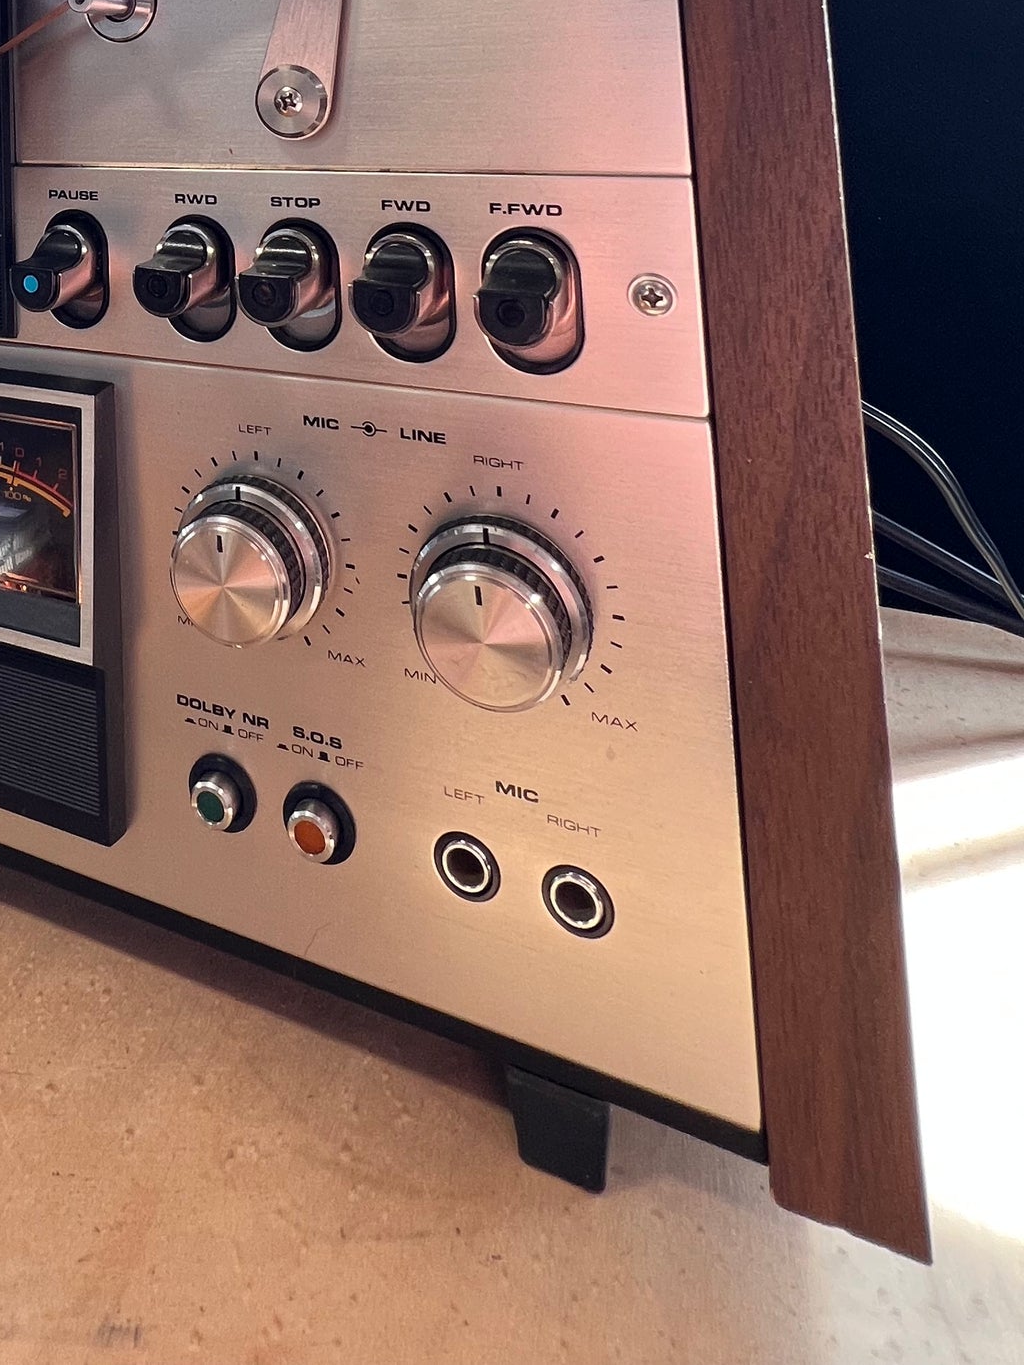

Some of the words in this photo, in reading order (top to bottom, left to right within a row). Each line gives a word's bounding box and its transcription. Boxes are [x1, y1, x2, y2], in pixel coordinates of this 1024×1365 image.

[48, 189, 99, 201] PAUSE
[174, 193, 218, 205] RWD
[270, 196, 321, 209] STOP
[381, 199, 431, 213] FWD
[489, 202, 563, 217] F.FWD
[238, 424, 272, 436] LEFT
[303, 415, 340, 431] MIC
[400, 428, 447, 446] LINE
[15, 446, 25, 458] 0
[473, 455, 525, 472] RIGHT
[328, 650, 366, 668] MAX
[404, 667, 437, 684] MIN
[176, 694, 236, 719] DOLBY
[242, 712, 270, 729] NR
[198, 717, 219, 731] ON
[237, 728, 264, 742] OFF
[591, 711, 638, 732] MAX
[292, 725, 343, 750] S.O.S
[291, 744, 314, 758] ON
[334, 755, 364, 770] OFF
[443, 785, 484, 805] LEFT
[495, 780, 539, 803] MIC
[547, 814, 601, 838] RIGHT
